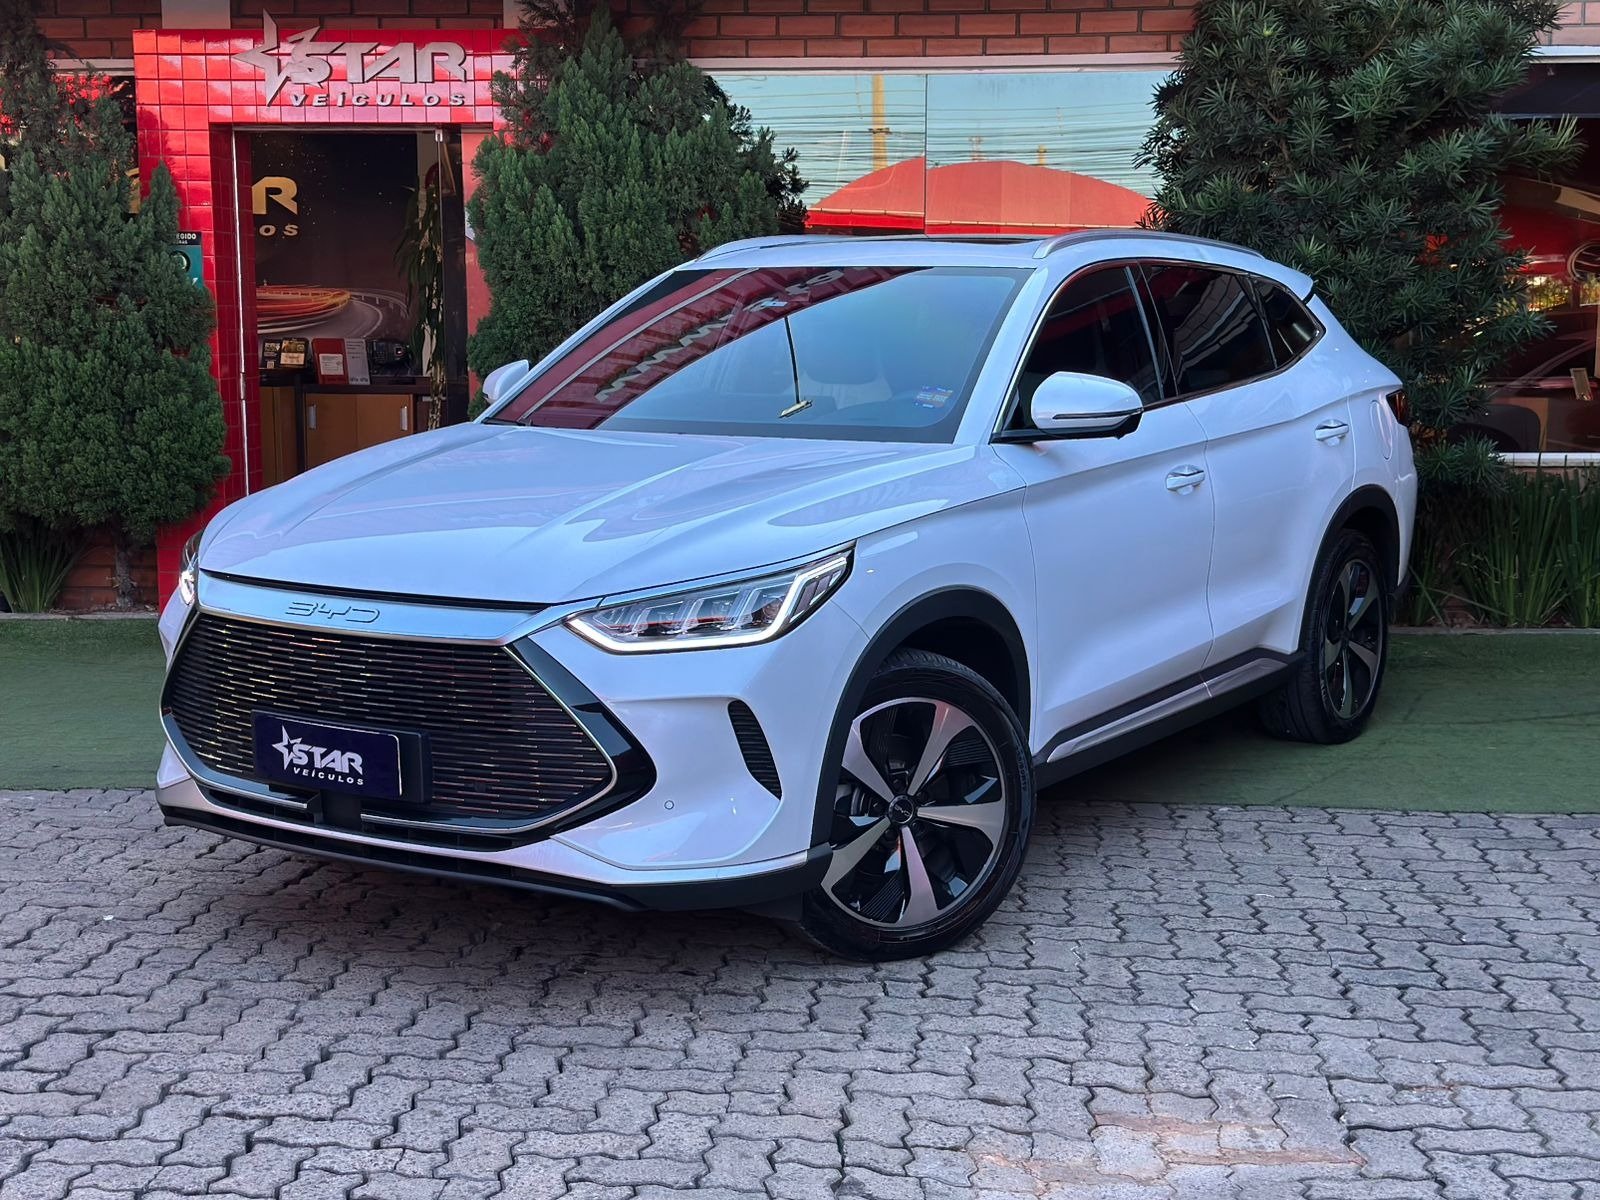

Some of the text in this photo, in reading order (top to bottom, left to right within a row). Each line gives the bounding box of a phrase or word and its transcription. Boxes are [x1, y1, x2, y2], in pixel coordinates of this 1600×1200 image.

[289, 41, 467, 85] STAR
[285, 602, 380, 623] BYD
[291, 743, 363, 776] STAR
